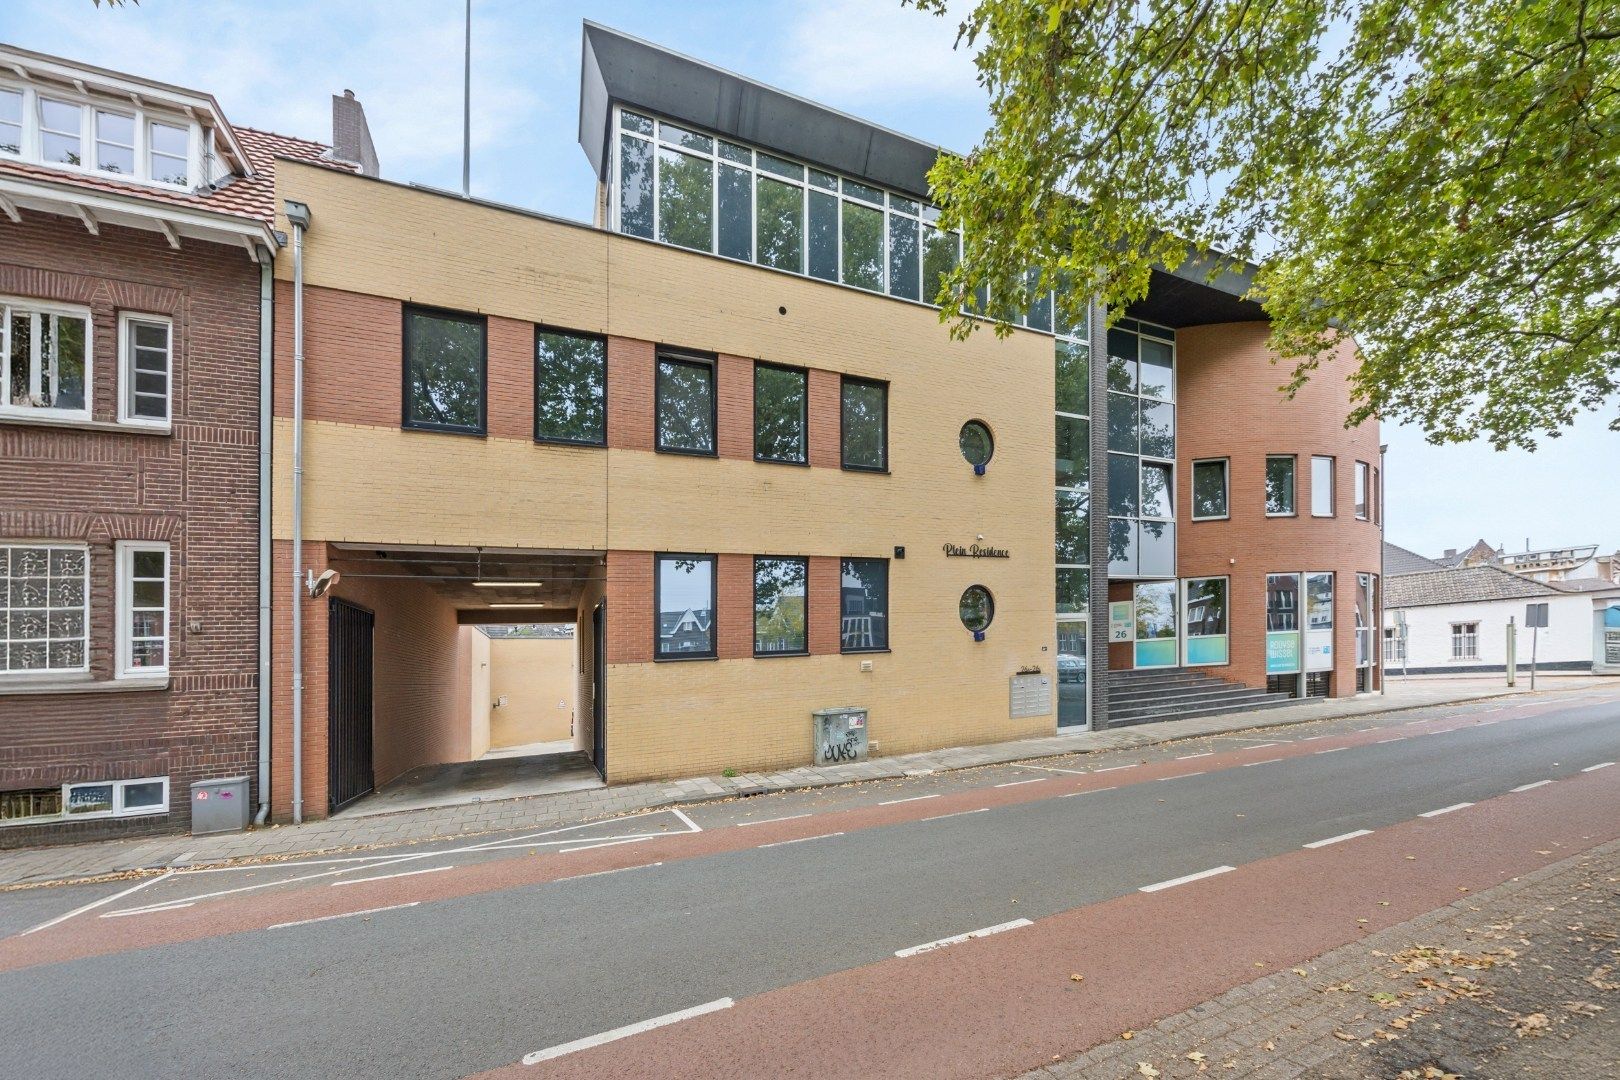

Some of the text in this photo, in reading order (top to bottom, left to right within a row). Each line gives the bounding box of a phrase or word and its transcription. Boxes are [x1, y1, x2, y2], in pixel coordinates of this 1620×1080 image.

[942, 543, 1010, 558] Plein Residence
[1115, 630, 1127, 639] 26
